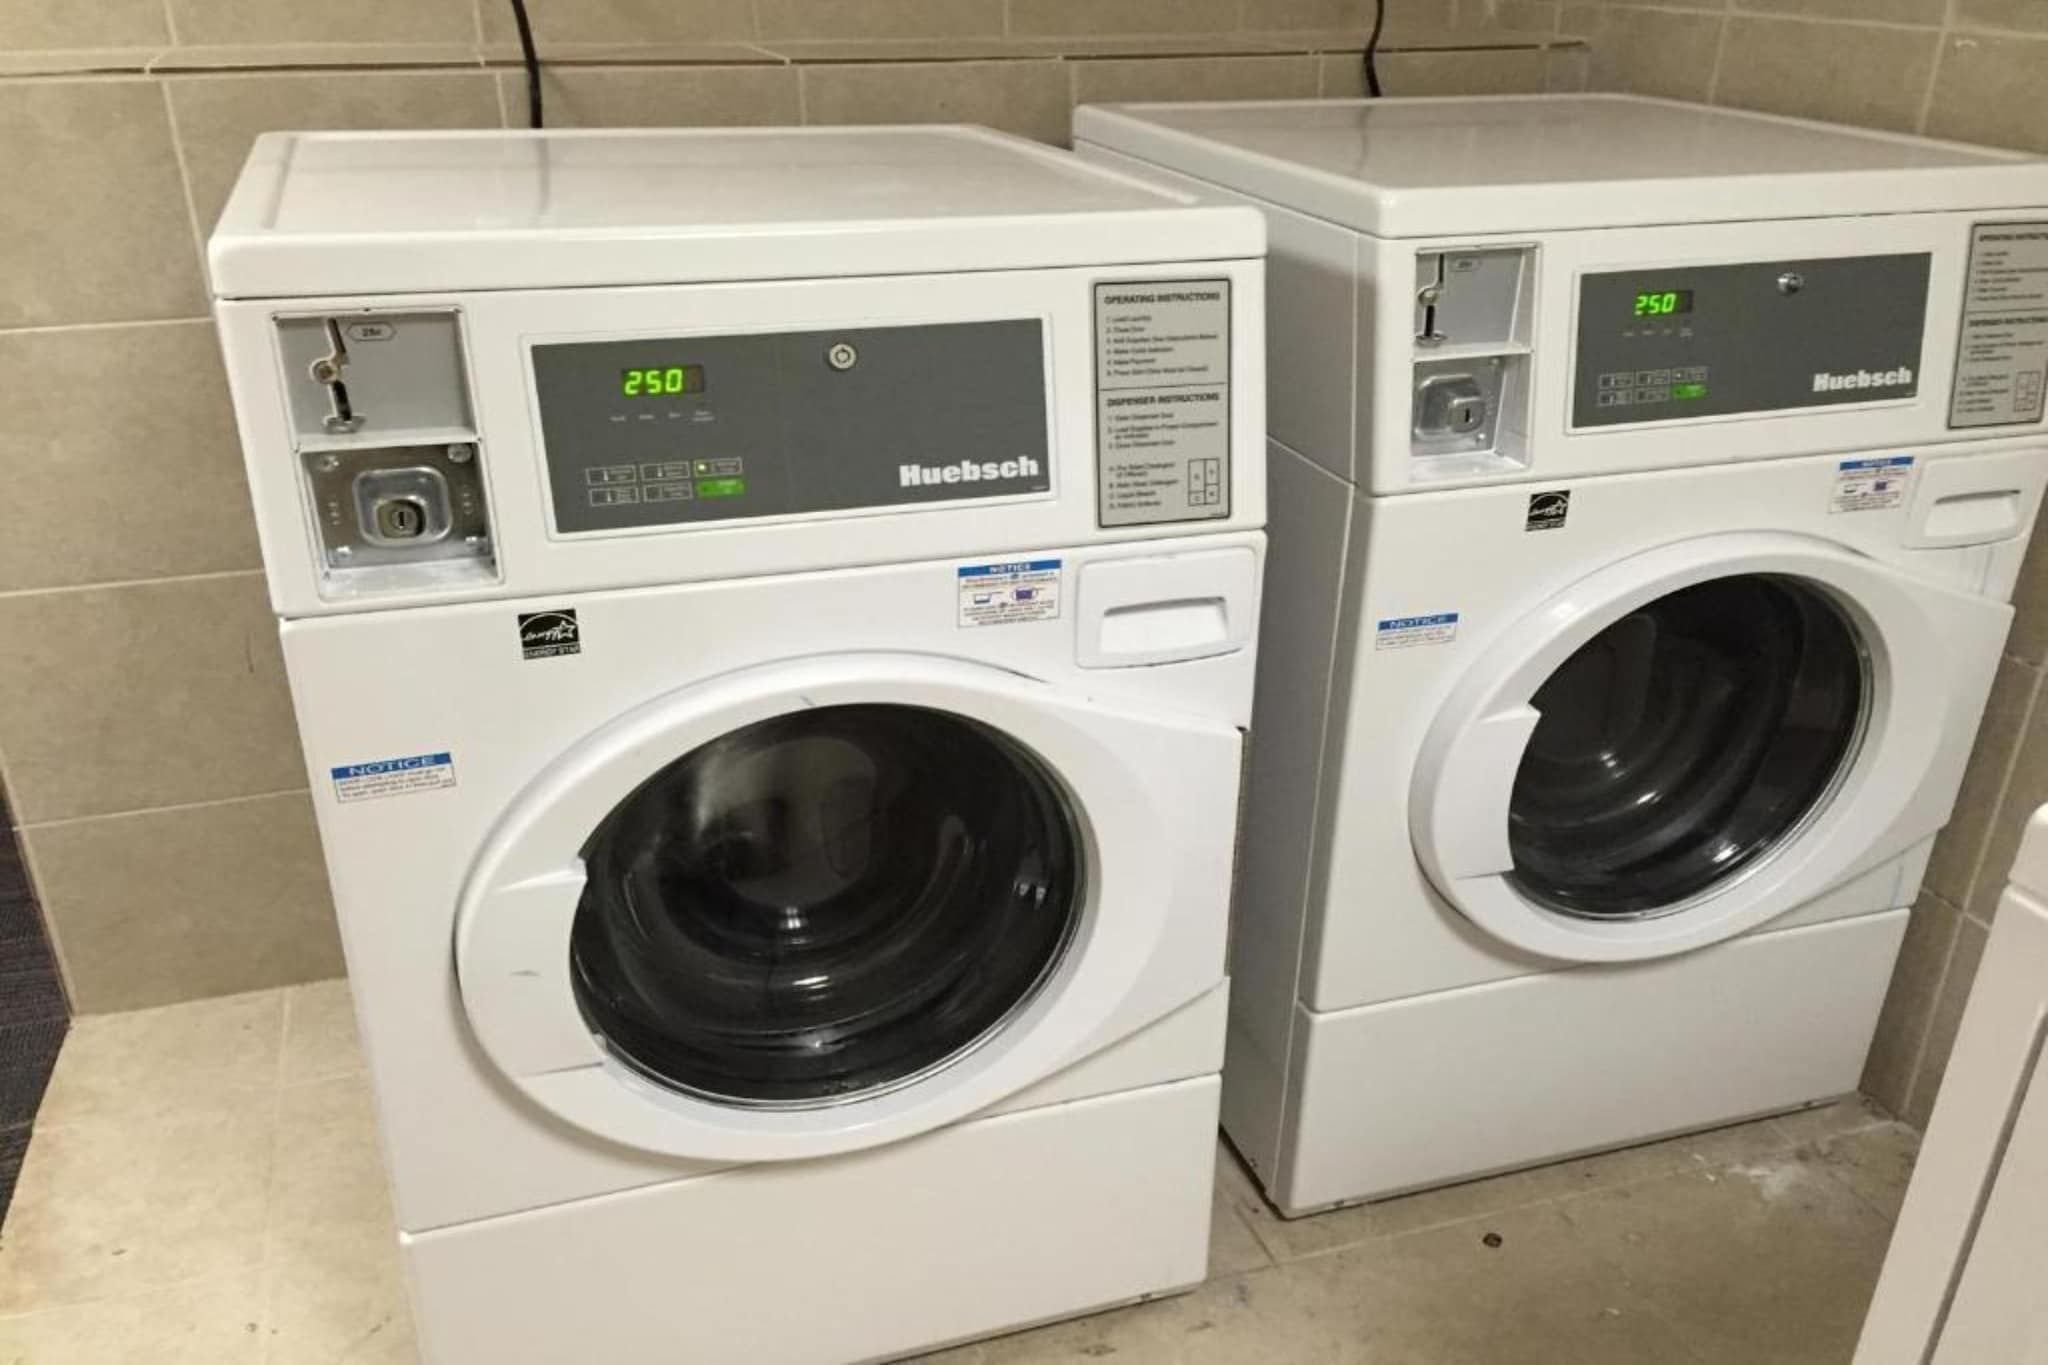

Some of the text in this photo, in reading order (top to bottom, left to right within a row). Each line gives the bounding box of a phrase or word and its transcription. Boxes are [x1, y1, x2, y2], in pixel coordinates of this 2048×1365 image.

[1104, 291, 1221, 305] OPERATING INSTRUCTIONS
[1634, 293, 1677, 315] 250
[623, 368, 684, 396] 250
[1812, 366, 1913, 392] Huebsch
[1107, 392, 1220, 408] DISPENSER INSTRUCTIONS
[899, 455, 1039, 488] Huebsch
[348, 756, 436, 775] NOTICE
